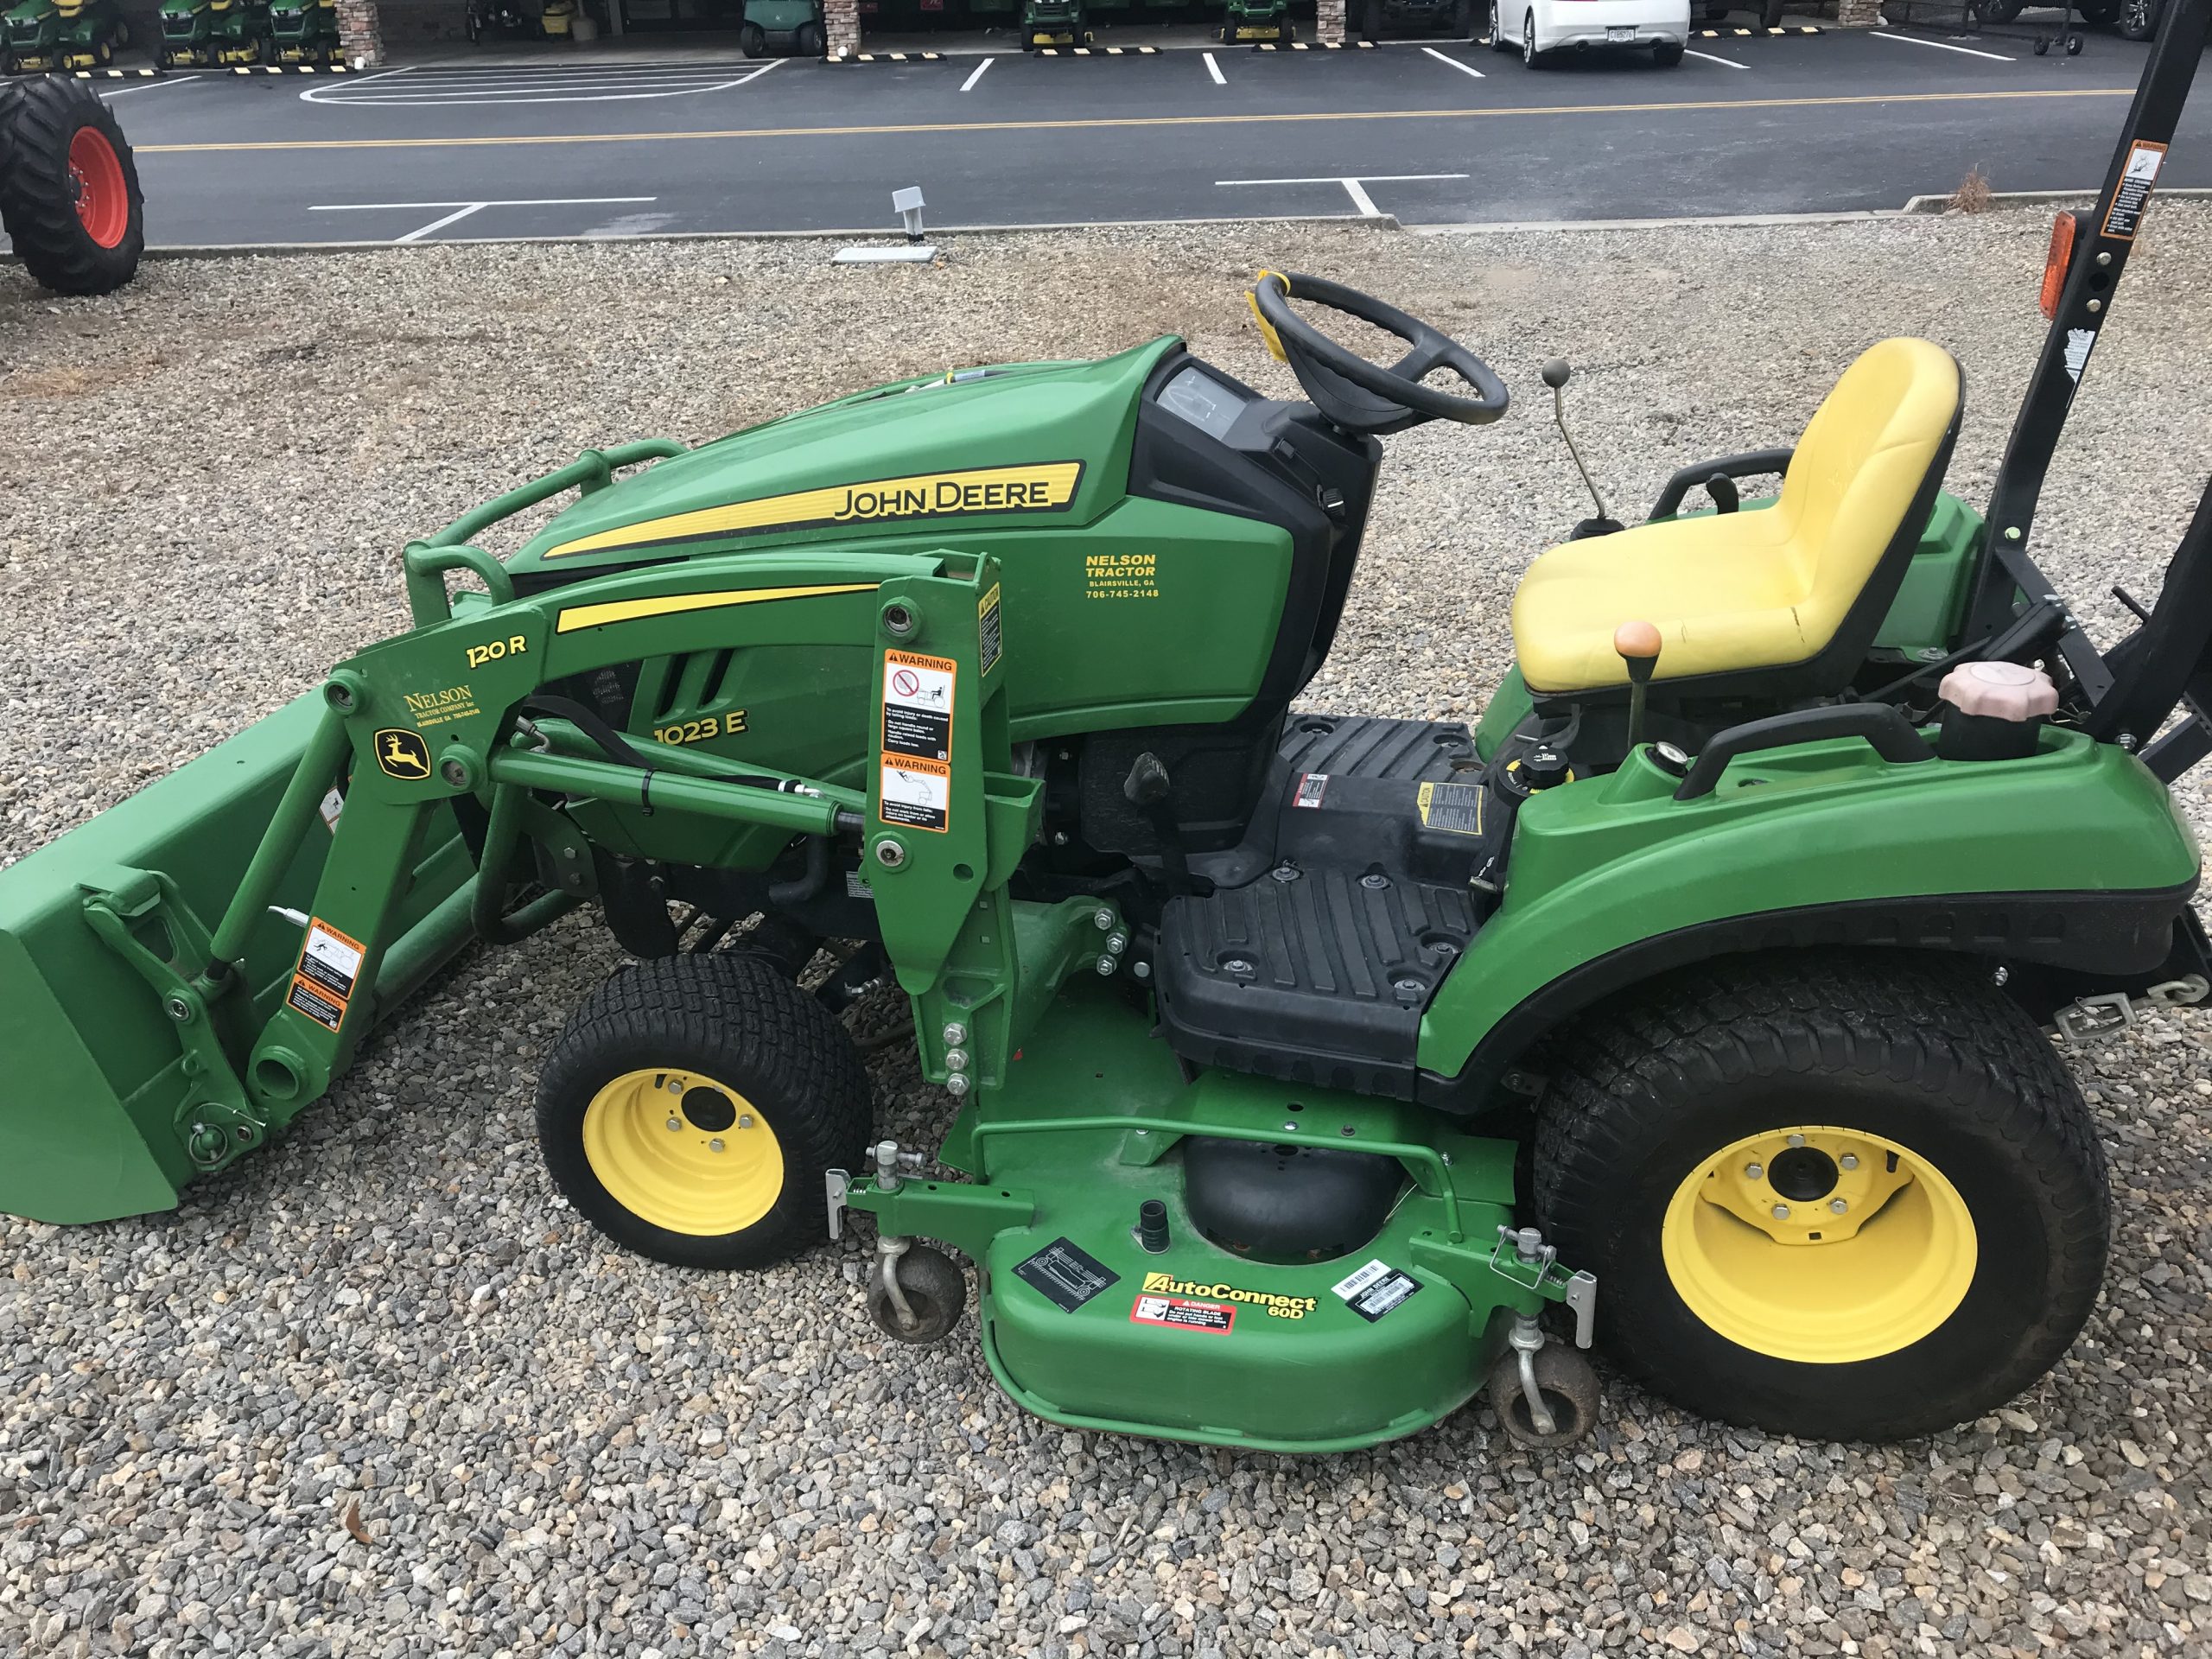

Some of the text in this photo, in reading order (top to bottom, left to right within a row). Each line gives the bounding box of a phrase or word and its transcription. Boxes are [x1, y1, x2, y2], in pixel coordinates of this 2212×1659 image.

[835, 481, 1049, 517] JOHN DEERE
[1086, 554, 1156, 566] NELSON
[1085, 567, 1155, 577] TRACTOR
[1086, 589, 1159, 598] 706-745-2148
[467, 635, 526, 668] 120 R
[899, 653, 952, 671] WARNING
[404, 685, 473, 712] NELSON
[415, 709, 440, 721] TRACTOR
[440, 703, 466, 714] COMPANY
[654, 710, 746, 745] 1023 E
[894, 758, 946, 775] WARNING
[326, 926, 360, 950] WARNING
[308, 983, 340, 1007] WARNING
[1145, 1275, 1318, 1312] AutoConnect
[1267, 1306, 1305, 1319] 60D
